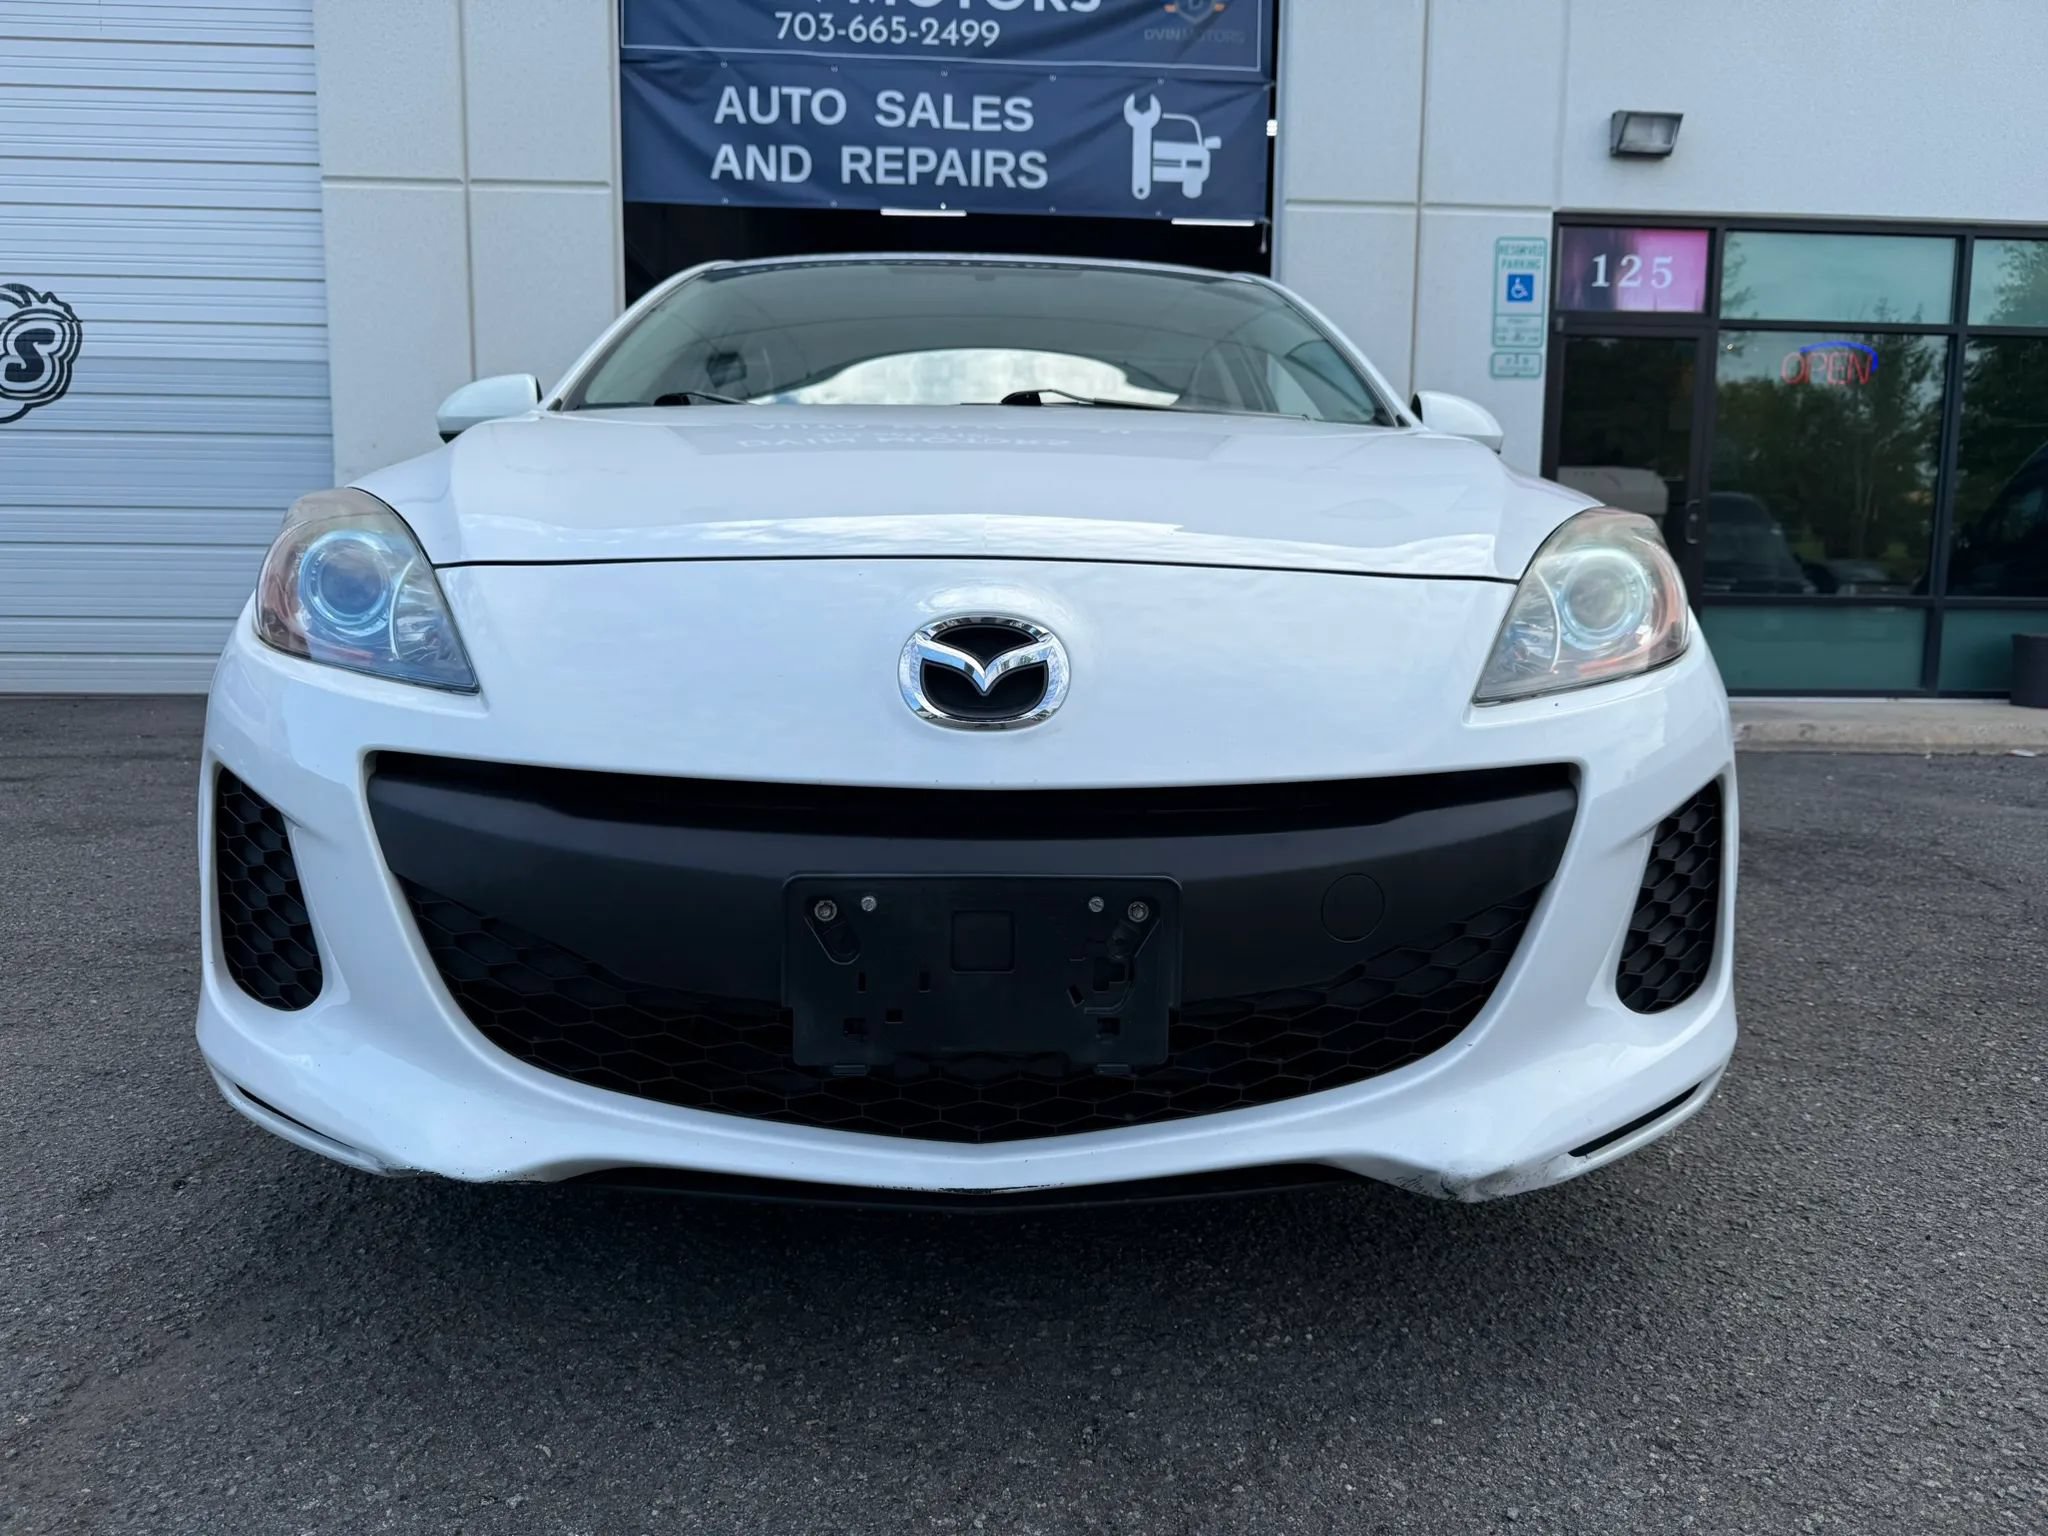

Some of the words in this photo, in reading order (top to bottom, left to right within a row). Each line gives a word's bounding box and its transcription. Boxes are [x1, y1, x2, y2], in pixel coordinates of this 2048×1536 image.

[775, 12, 1000, 48] 703-665-2499
[714, 86, 847, 125] AUTO
[875, 90, 1034, 132] SALES
[710, 144, 812, 183] AND
[841, 145, 1048, 189] REPAIRS
[1591, 254, 1673, 288] 125
[1781, 351, 1873, 384] OPEN
